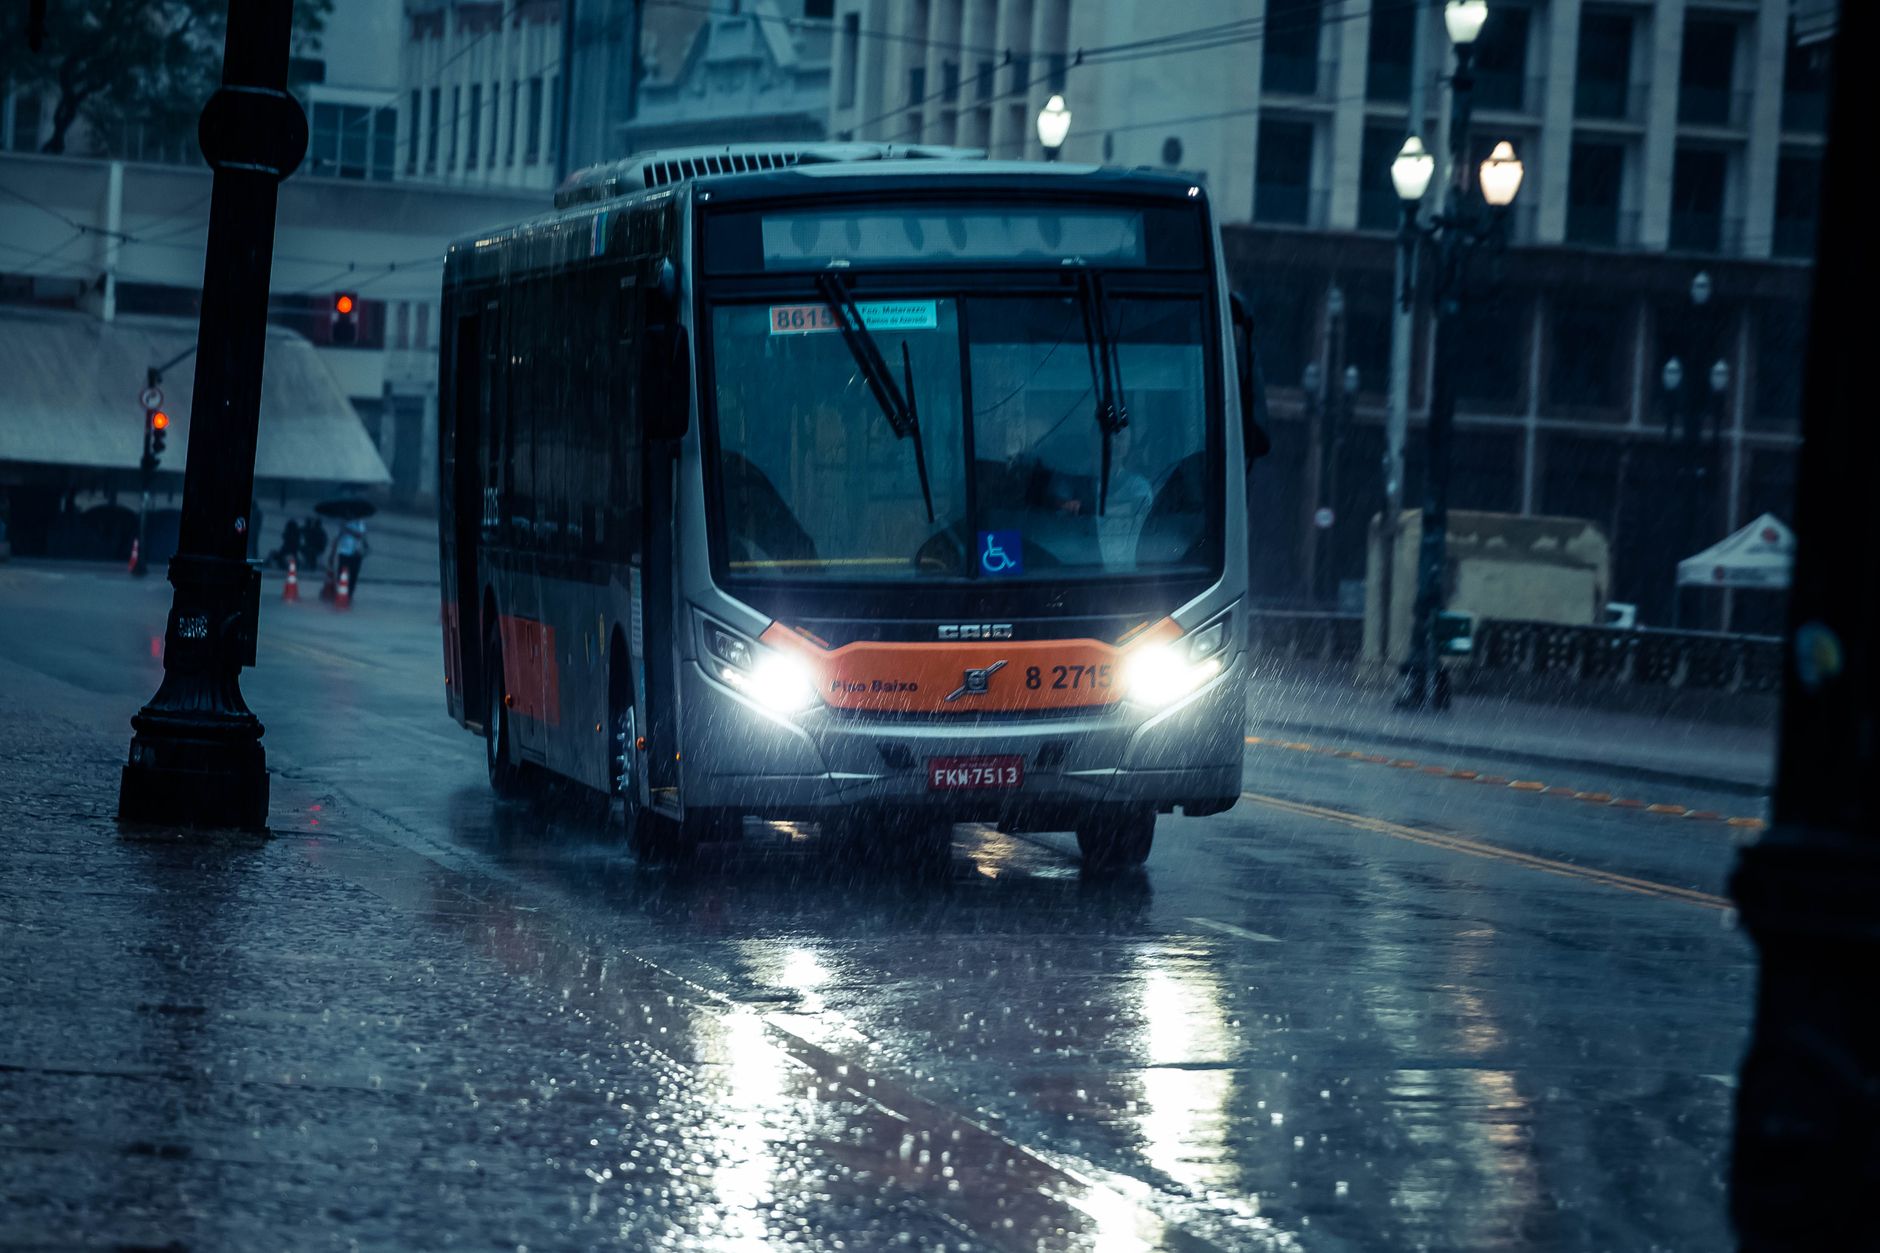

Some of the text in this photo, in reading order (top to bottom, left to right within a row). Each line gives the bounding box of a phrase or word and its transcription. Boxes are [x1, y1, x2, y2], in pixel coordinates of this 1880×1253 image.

[872, 680, 918, 692] Baixo
[1025, 664, 1114, 690] 8 2715
